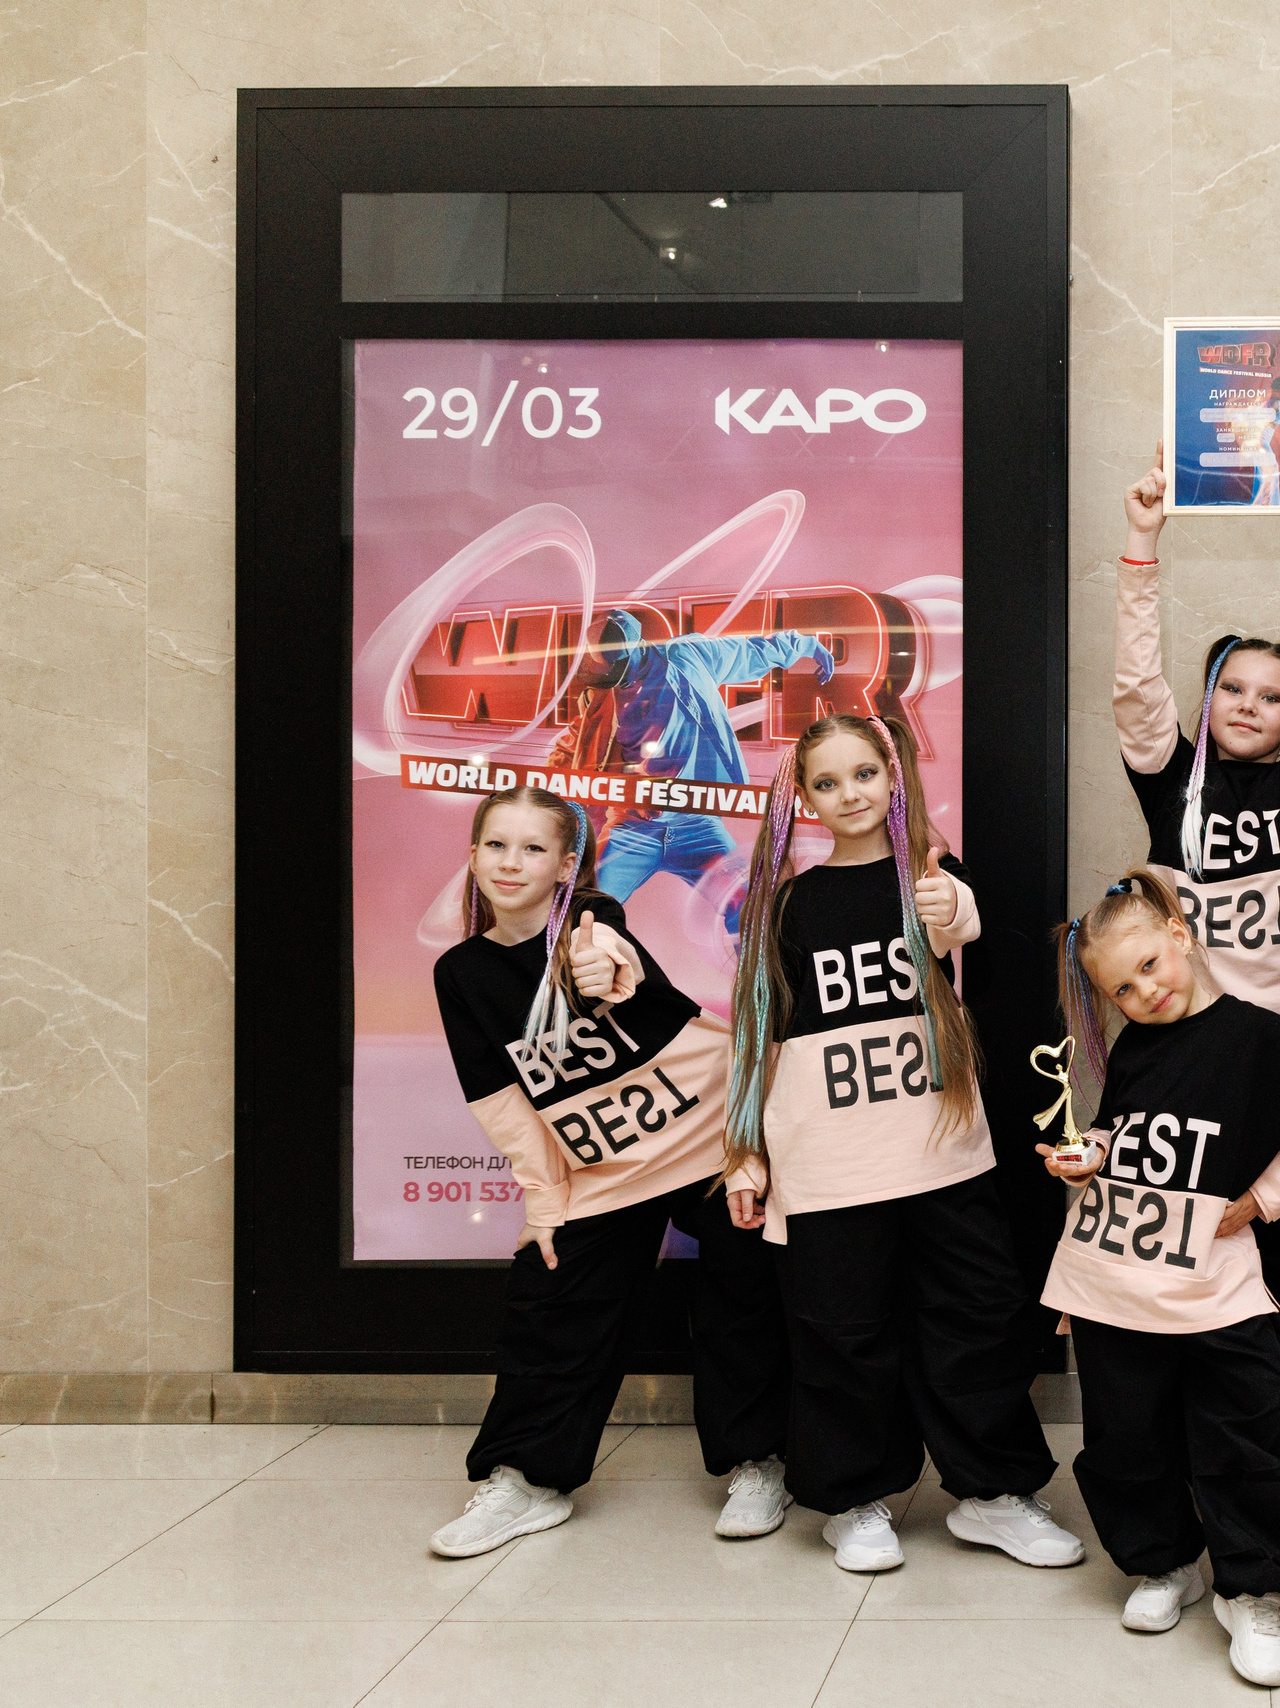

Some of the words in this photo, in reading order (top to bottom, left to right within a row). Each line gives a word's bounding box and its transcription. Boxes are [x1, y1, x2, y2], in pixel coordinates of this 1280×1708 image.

[402, 380, 602, 447] 29/03
[1209, 389, 1266, 400] ДИПЛОМ
[408, 760, 517, 791] WORLD
[526, 771, 626, 802] DANCE
[1202, 809, 1280, 869] EST
[813, 937, 918, 1014] BES
[505, 1001, 640, 1098] BEST
[403, 1155, 484, 1170] ТЕЛЕФОН
[486, 1156, 512, 1171] ДЛ
[1111, 1112, 1221, 1190] EST
[403, 1181, 421, 1203] 8
[427, 1181, 472, 1203] 901
[479, 1181, 525, 1203] 537
